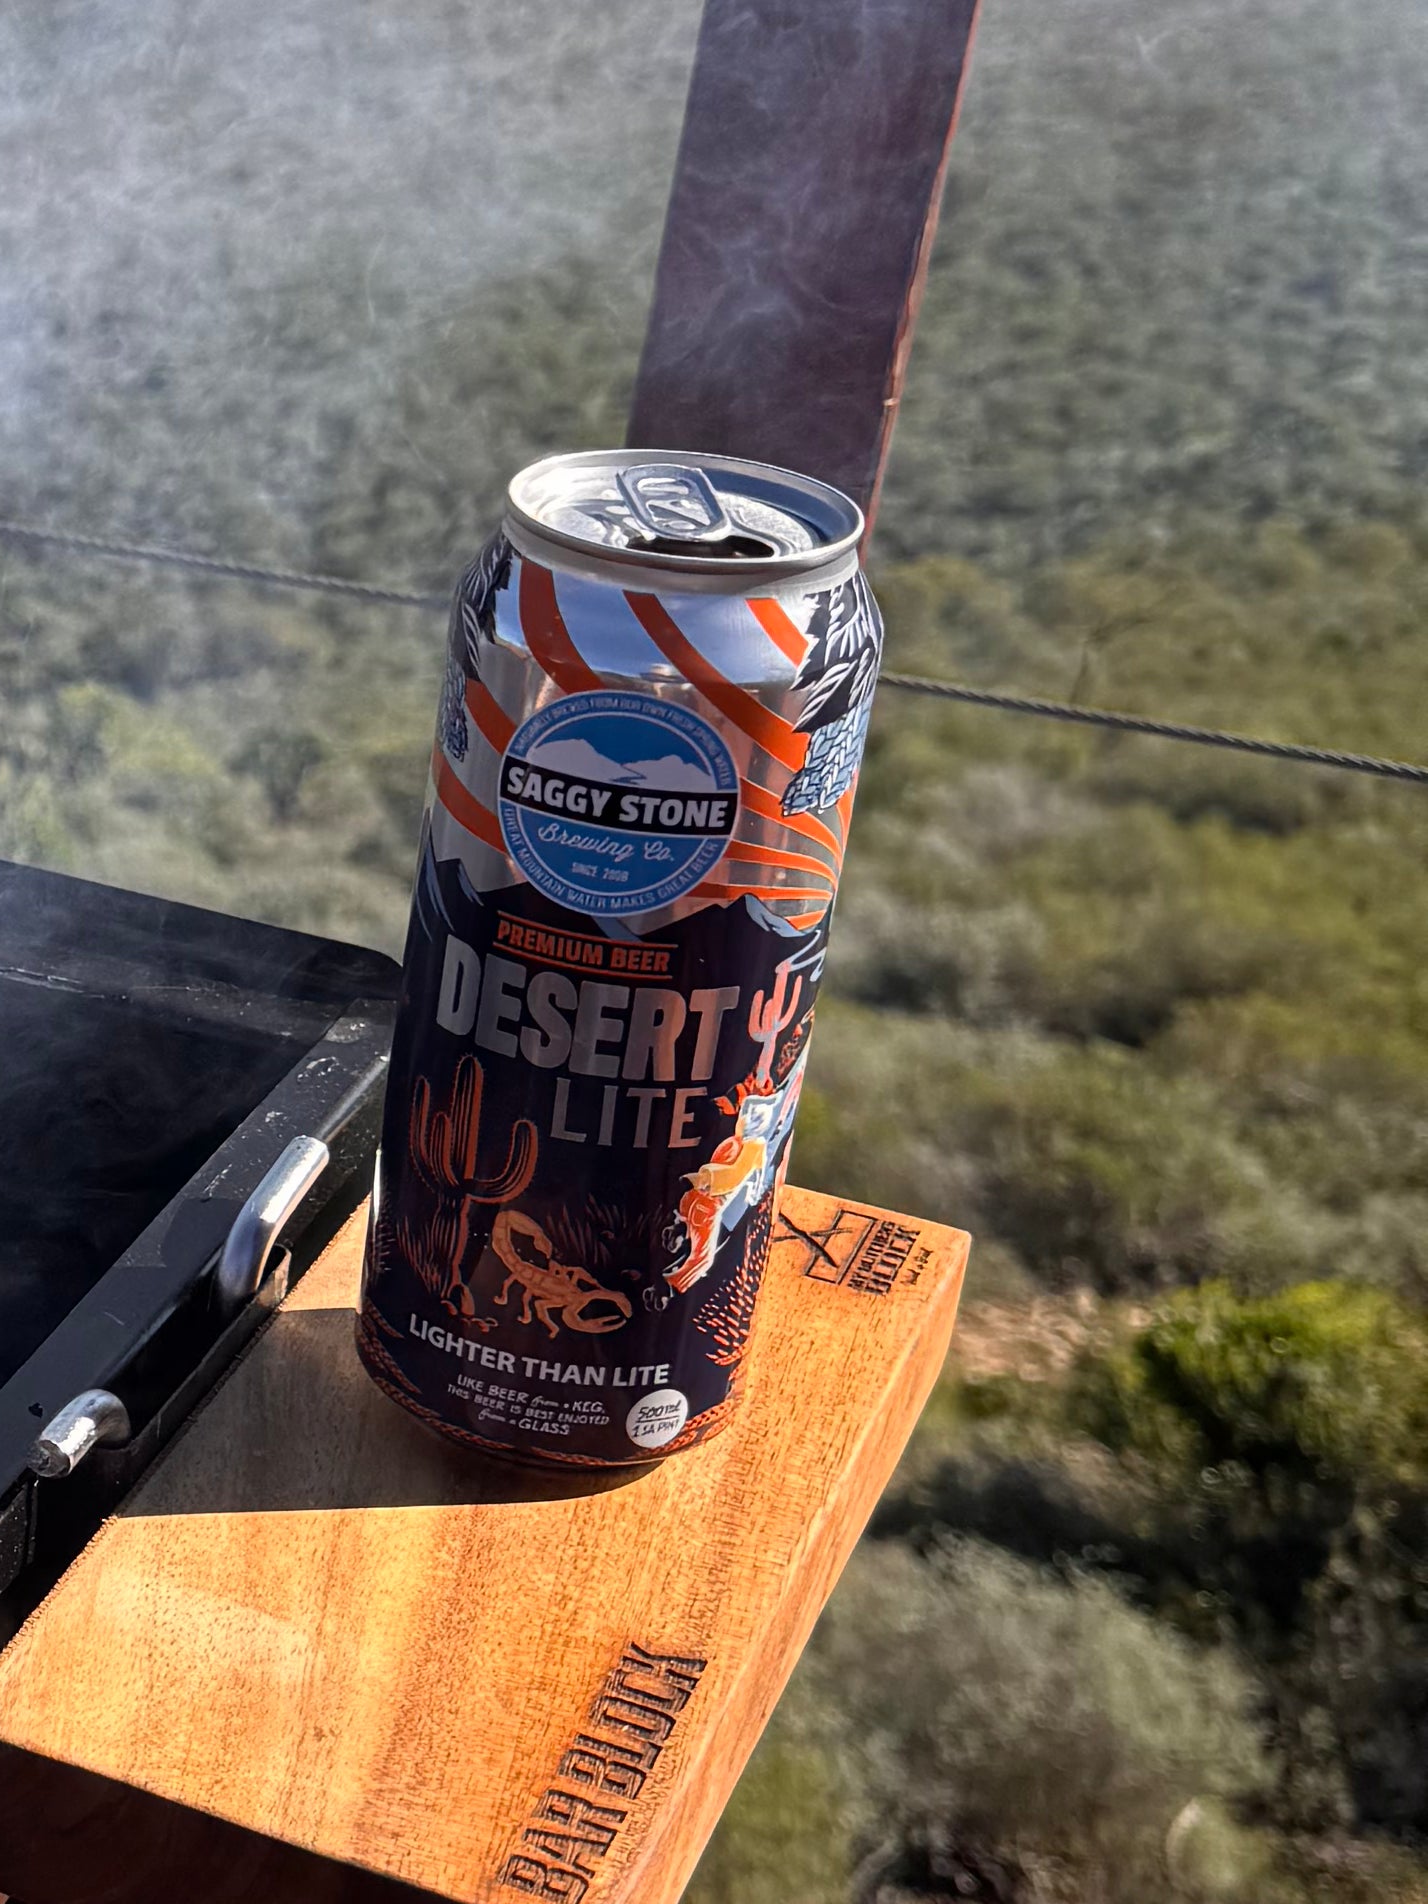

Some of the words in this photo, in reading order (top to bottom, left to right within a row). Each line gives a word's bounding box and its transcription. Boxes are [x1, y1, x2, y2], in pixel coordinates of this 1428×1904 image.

[507, 766, 612, 817] SAGGY
[619, 795, 728, 828] STONE
[504, 807, 524, 846] GREAT
[516, 847, 564, 896] MOUNTAIN
[566, 889, 607, 908] WATER
[610, 892, 656, 909] MAKES
[657, 870, 693, 898] GREAT
[692, 842, 719, 872] BEER
[538, 823, 635, 862] Brewing
[644, 841, 675, 862] Co.
[571, 862, 599, 878] SINCE
[497, 919, 603, 966] PREMIUM
[610, 947, 670, 972] BEER
[436, 934, 741, 1081] DESERT
[550, 1077, 708, 1148] LITE
[409, 1313, 515, 1373] LIGHTER
[521, 1356, 605, 1386] THAN
[613, 1363, 670, 1387] LITE
[447, 1383, 470, 1399] THIS
[474, 1394, 505, 1411] BEER
[510, 1404, 522, 1414] IS
[525, 1408, 554, 1420] BEST
[557, 1412, 610, 1425] ENJOYED
[457, 1374, 484, 1392] LIKE
[488, 1384, 529, 1403] BEER
[518, 1418, 571, 1435] GLASS
[558, 1640, 708, 1800] BLOCK
